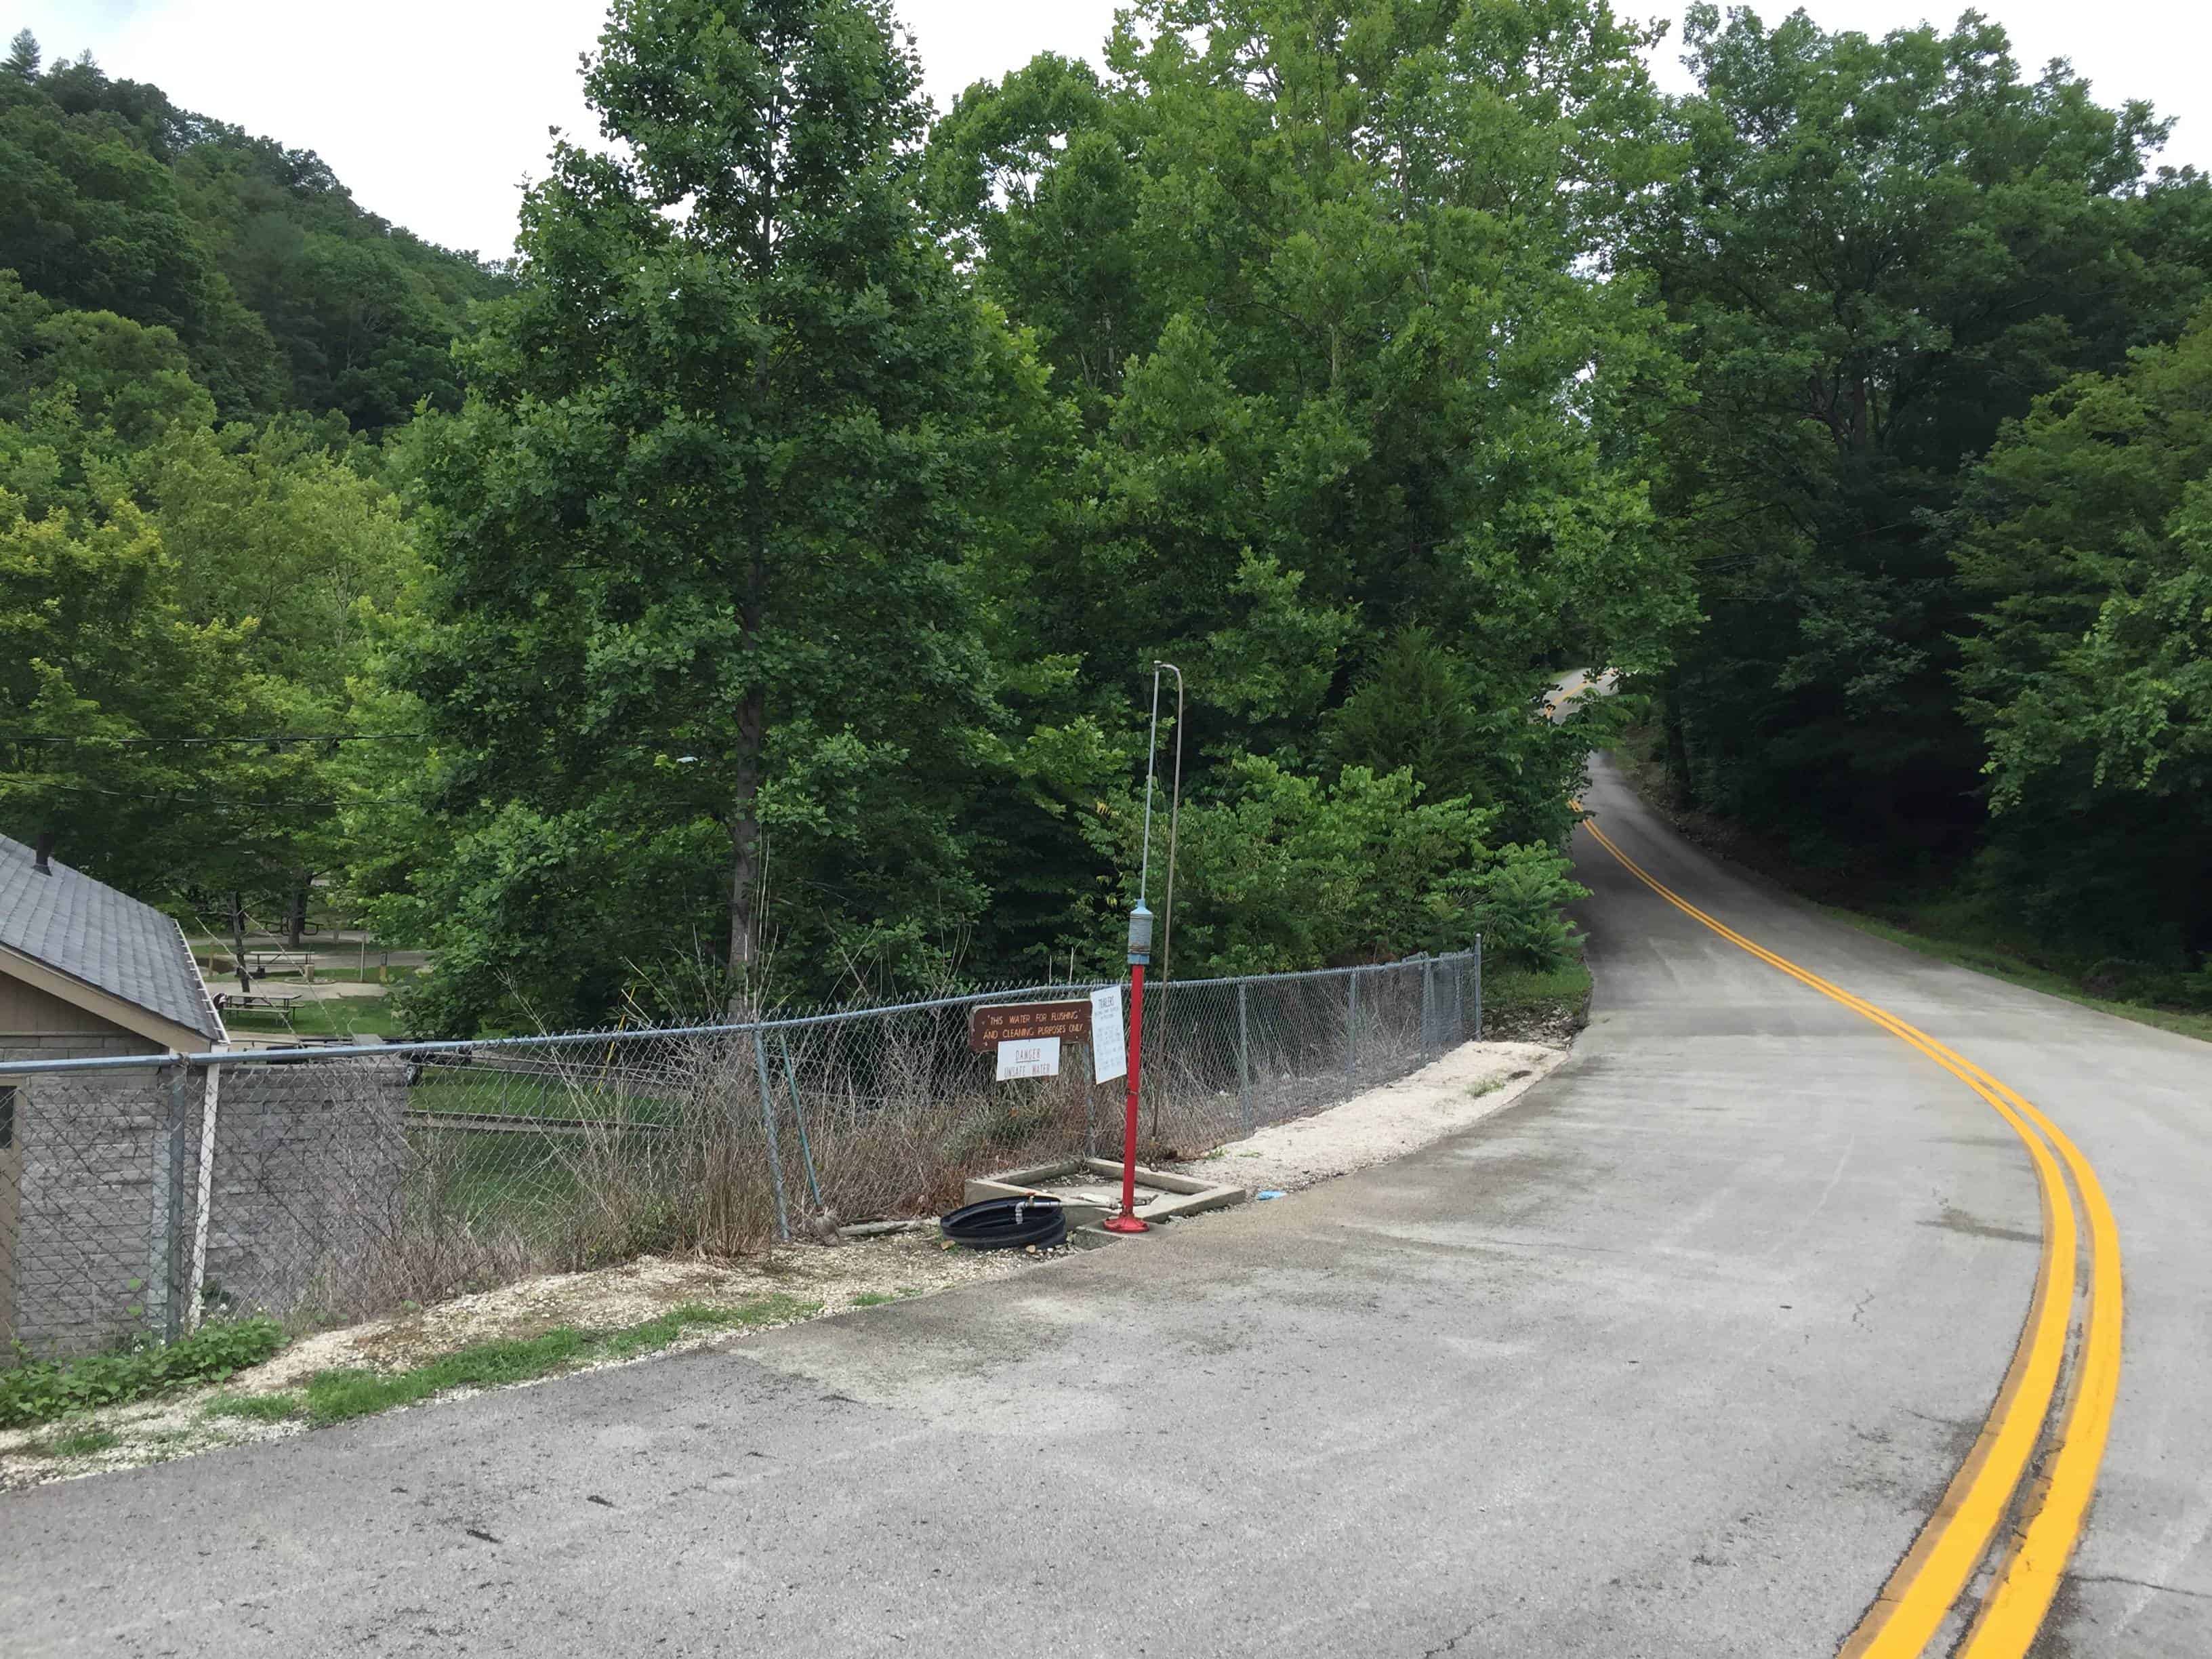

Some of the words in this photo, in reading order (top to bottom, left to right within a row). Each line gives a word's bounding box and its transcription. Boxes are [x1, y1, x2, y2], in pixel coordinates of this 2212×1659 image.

[1009, 1014, 1030, 1024] WATER
[1036, 1013, 1047, 1022] FOR
[983, 1029, 998, 1040] AND
[1002, 1027, 1033, 1038] CLEANING
[1038, 1024, 1065, 1035] PURPOSES
[1015, 1048, 1041, 1060] DANGER
[1004, 1065, 1025, 1078] UNSAFE
[1032, 1063, 1050, 1075] WATER
